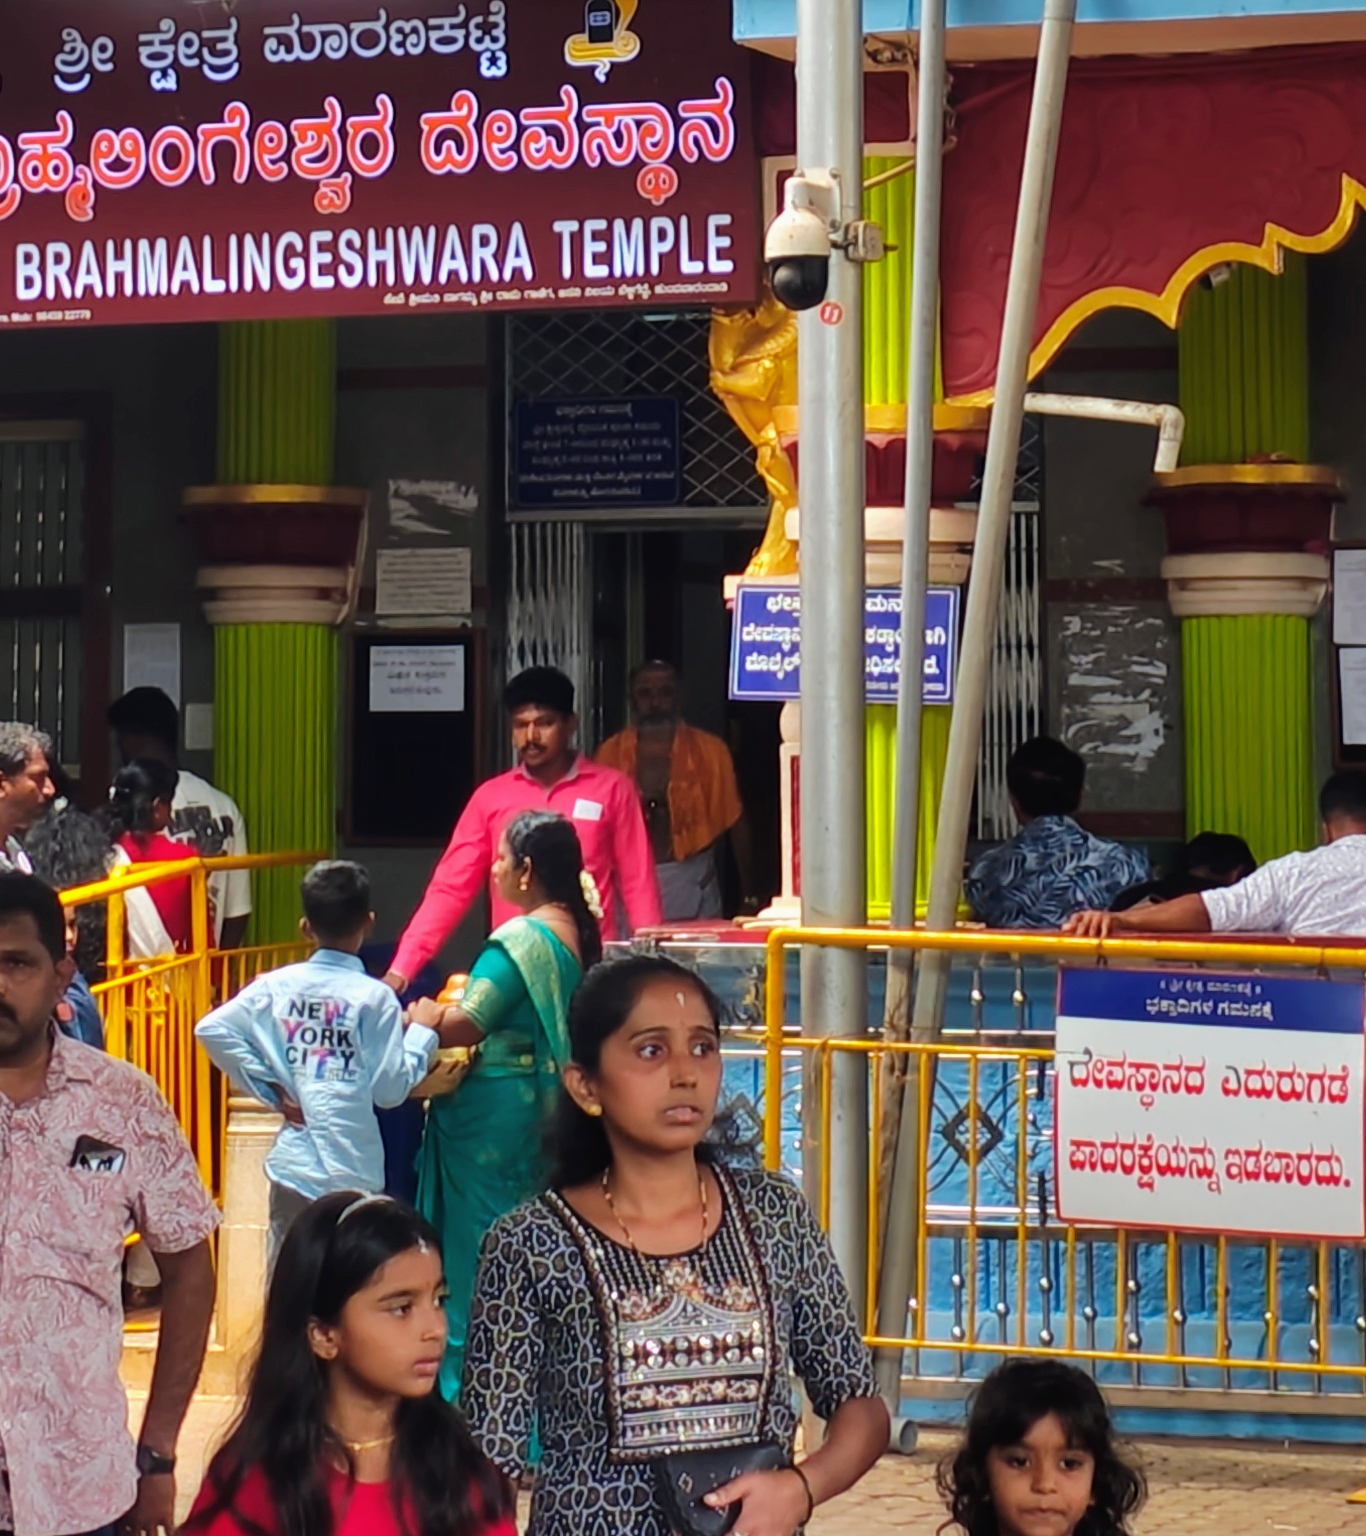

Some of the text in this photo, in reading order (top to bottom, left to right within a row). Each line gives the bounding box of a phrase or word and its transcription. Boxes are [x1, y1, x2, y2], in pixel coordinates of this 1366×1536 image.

[54, 27, 115, 92] ಶ್ರೀ
[137, 15, 240, 92] ಕ್ಷೇತ್ರ
[420, 75, 734, 206] ದೇವಸ್ಥಾನ
[15, 221, 534, 301] BRAHMALINGESHWARA
[553, 214, 735, 281] TEMPLE
[280, 1018, 354, 1048] YORK
[288, 998, 353, 1026] NEW
[285, 1046, 355, 1079] CITY
[1068, 1046, 1350, 1112] ದೇವಸ್ಥಾನದ ಎದುರುಗಡೆ
[1068, 1132, 1351, 1195] ಪಾದರಕ್ಷೆಯನ್ನು ಇಡಬಾರದು.
